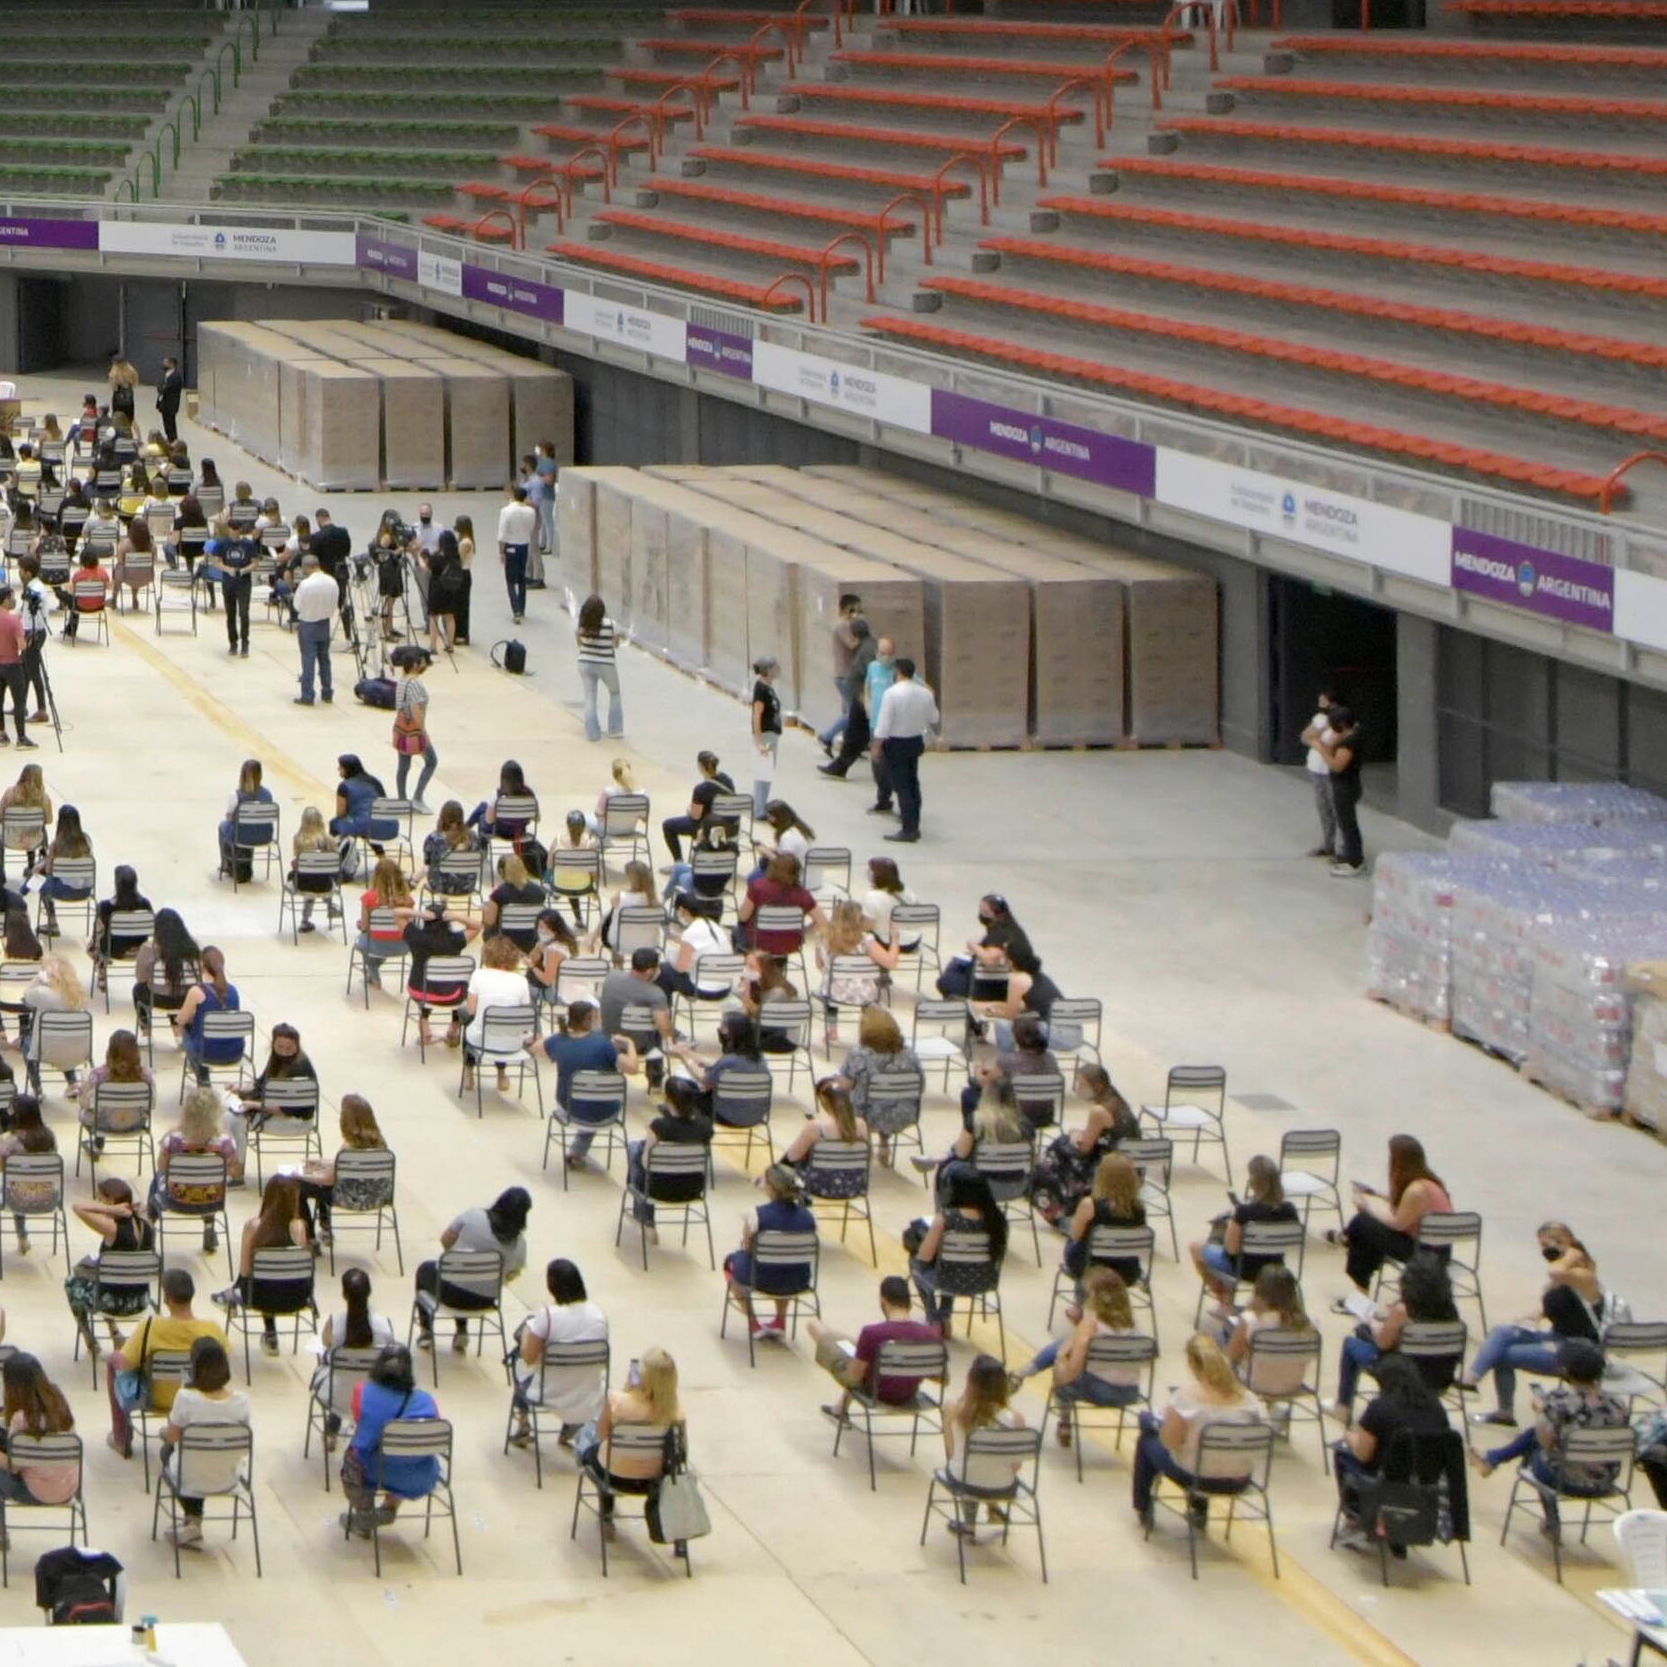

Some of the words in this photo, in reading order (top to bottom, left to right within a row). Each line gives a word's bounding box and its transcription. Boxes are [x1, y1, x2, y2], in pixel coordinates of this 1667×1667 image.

[233, 233, 277, 245] MENDOZA
[989, 420, 1029, 443] MENDOZA
[1044, 436, 1091, 461] ARGENTINA
[1304, 499, 1358, 525] MENDOZA
[1455, 551, 1516, 583] MENDOZA
[1536, 574, 1611, 610] ARGENTINA
